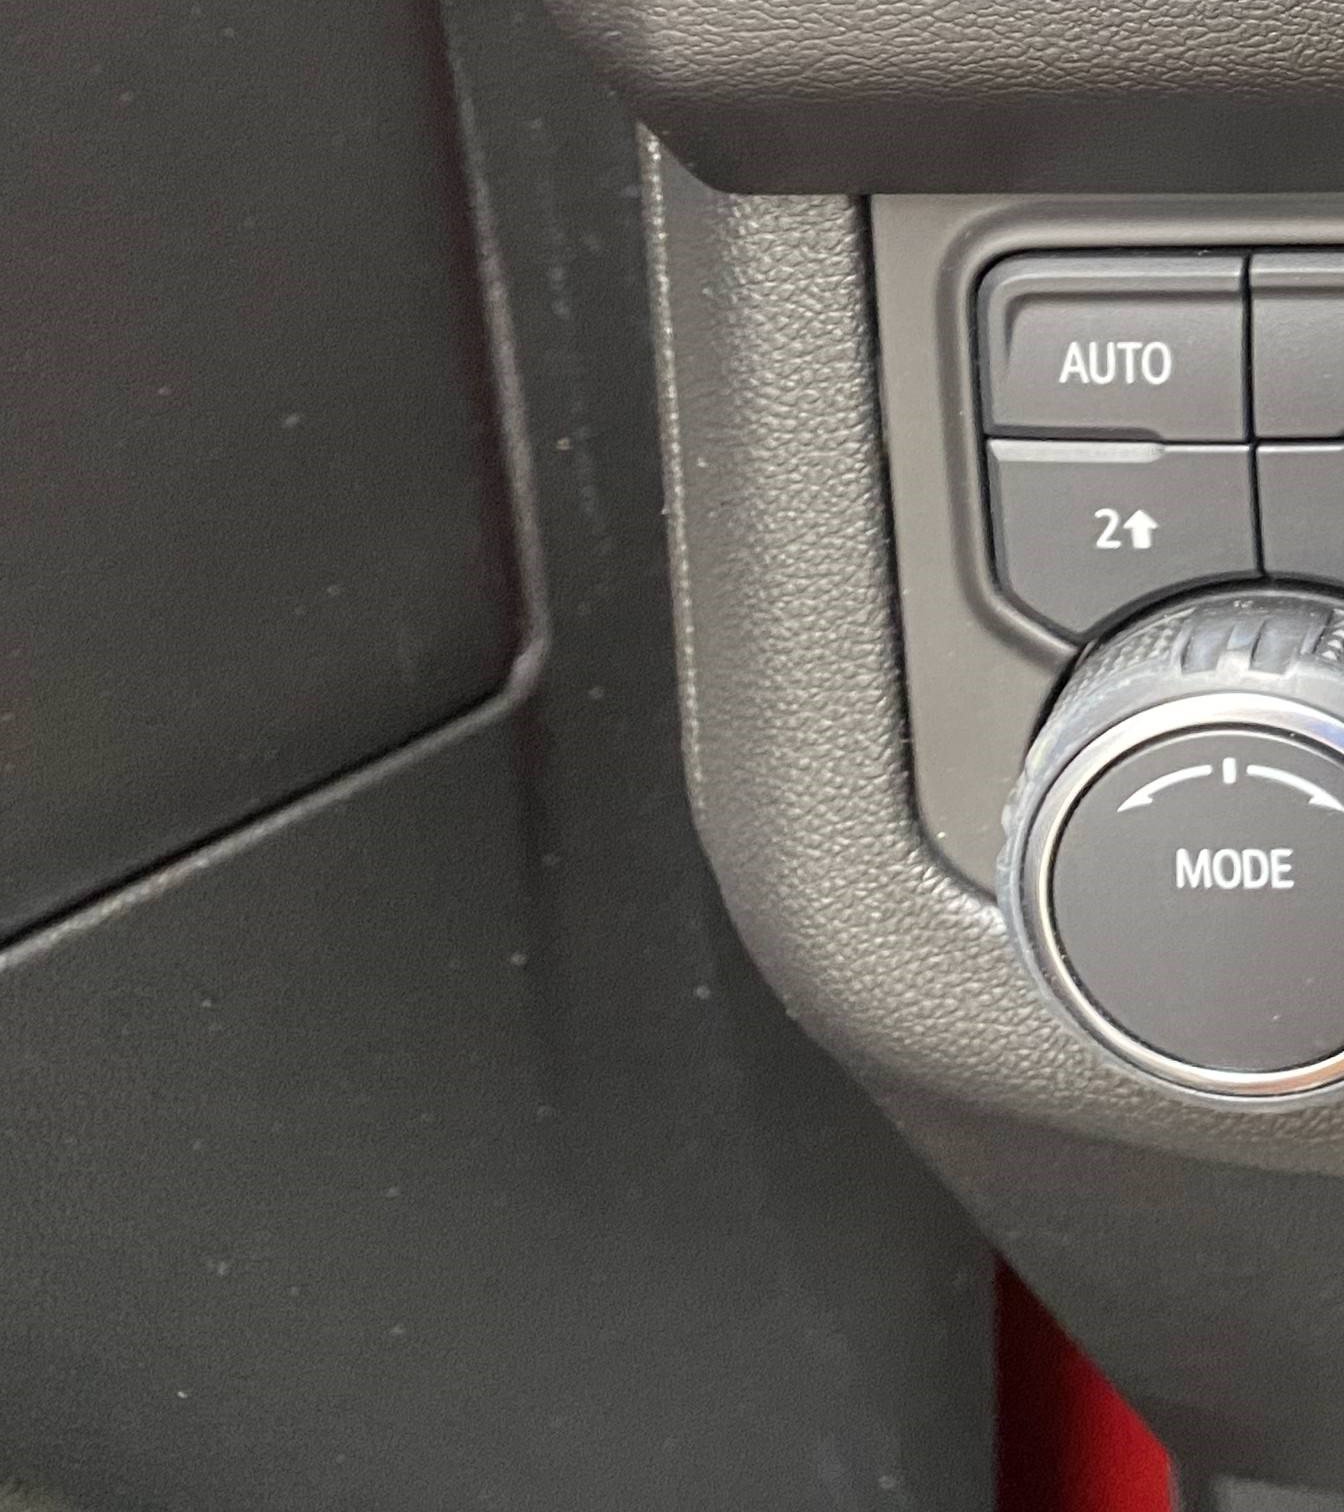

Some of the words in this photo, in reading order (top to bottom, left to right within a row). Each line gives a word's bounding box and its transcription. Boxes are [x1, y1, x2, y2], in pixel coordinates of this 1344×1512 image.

[1059, 341, 1172, 384] AUTO
[1094, 508, 1121, 549] 2
[1175, 847, 1295, 889] MODE
